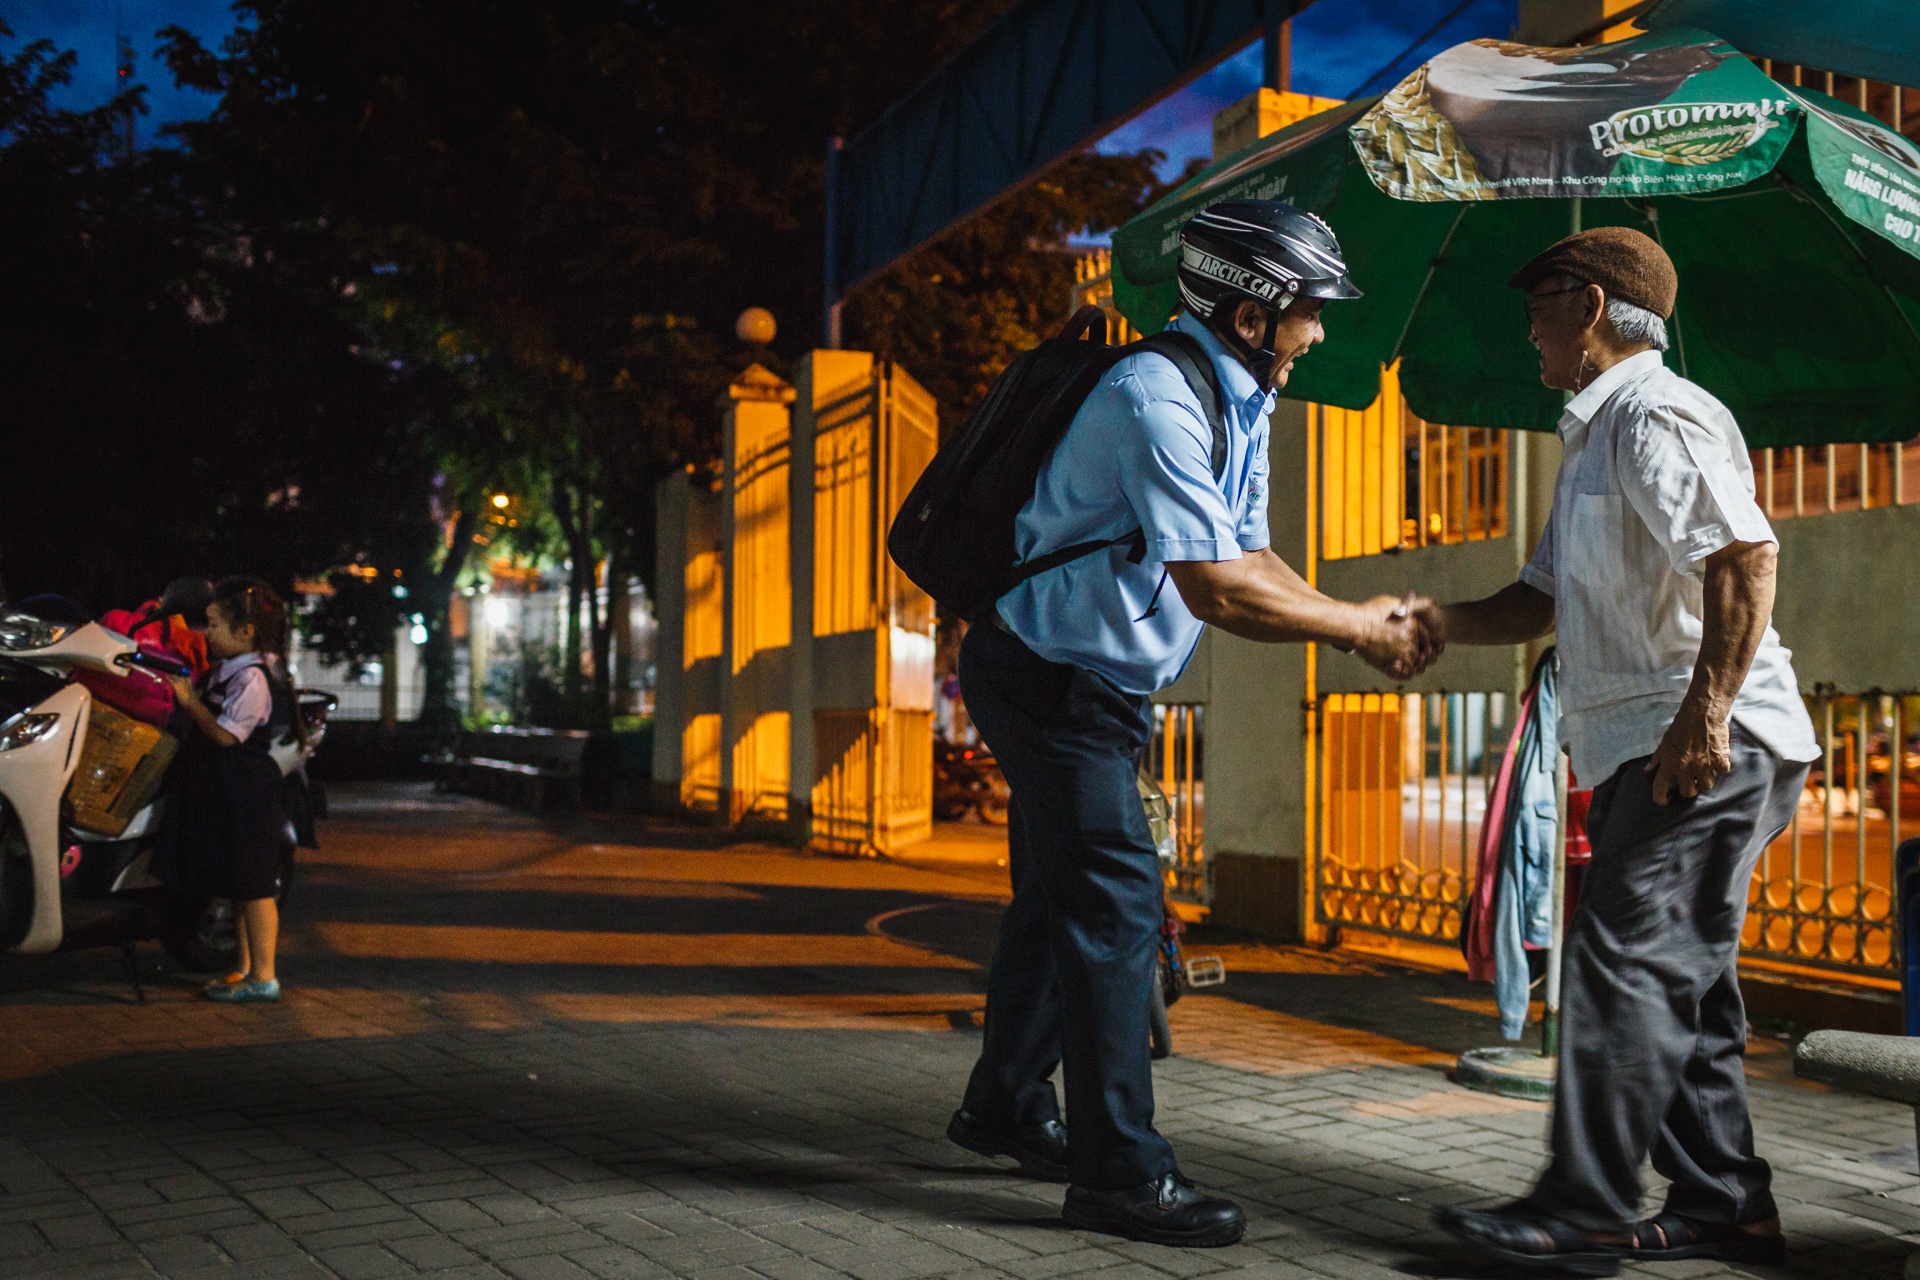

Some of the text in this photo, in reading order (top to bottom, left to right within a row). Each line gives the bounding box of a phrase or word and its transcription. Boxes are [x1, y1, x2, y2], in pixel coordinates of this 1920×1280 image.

[1589, 99, 1790, 150] Protomalt
[1512, 176, 1530, 187] Việt
[1531, 176, 1554, 186] Nam
[1562, 176, 1581, 185] Khu
[1582, 175, 1607, 186] Công
[1643, 174, 1665, 183] Biên
[1725, 171, 1742, 180] Nai
[1884, 212, 1914, 239] CHO
[1200, 256, 1281, 300] ARCTIC CAT
